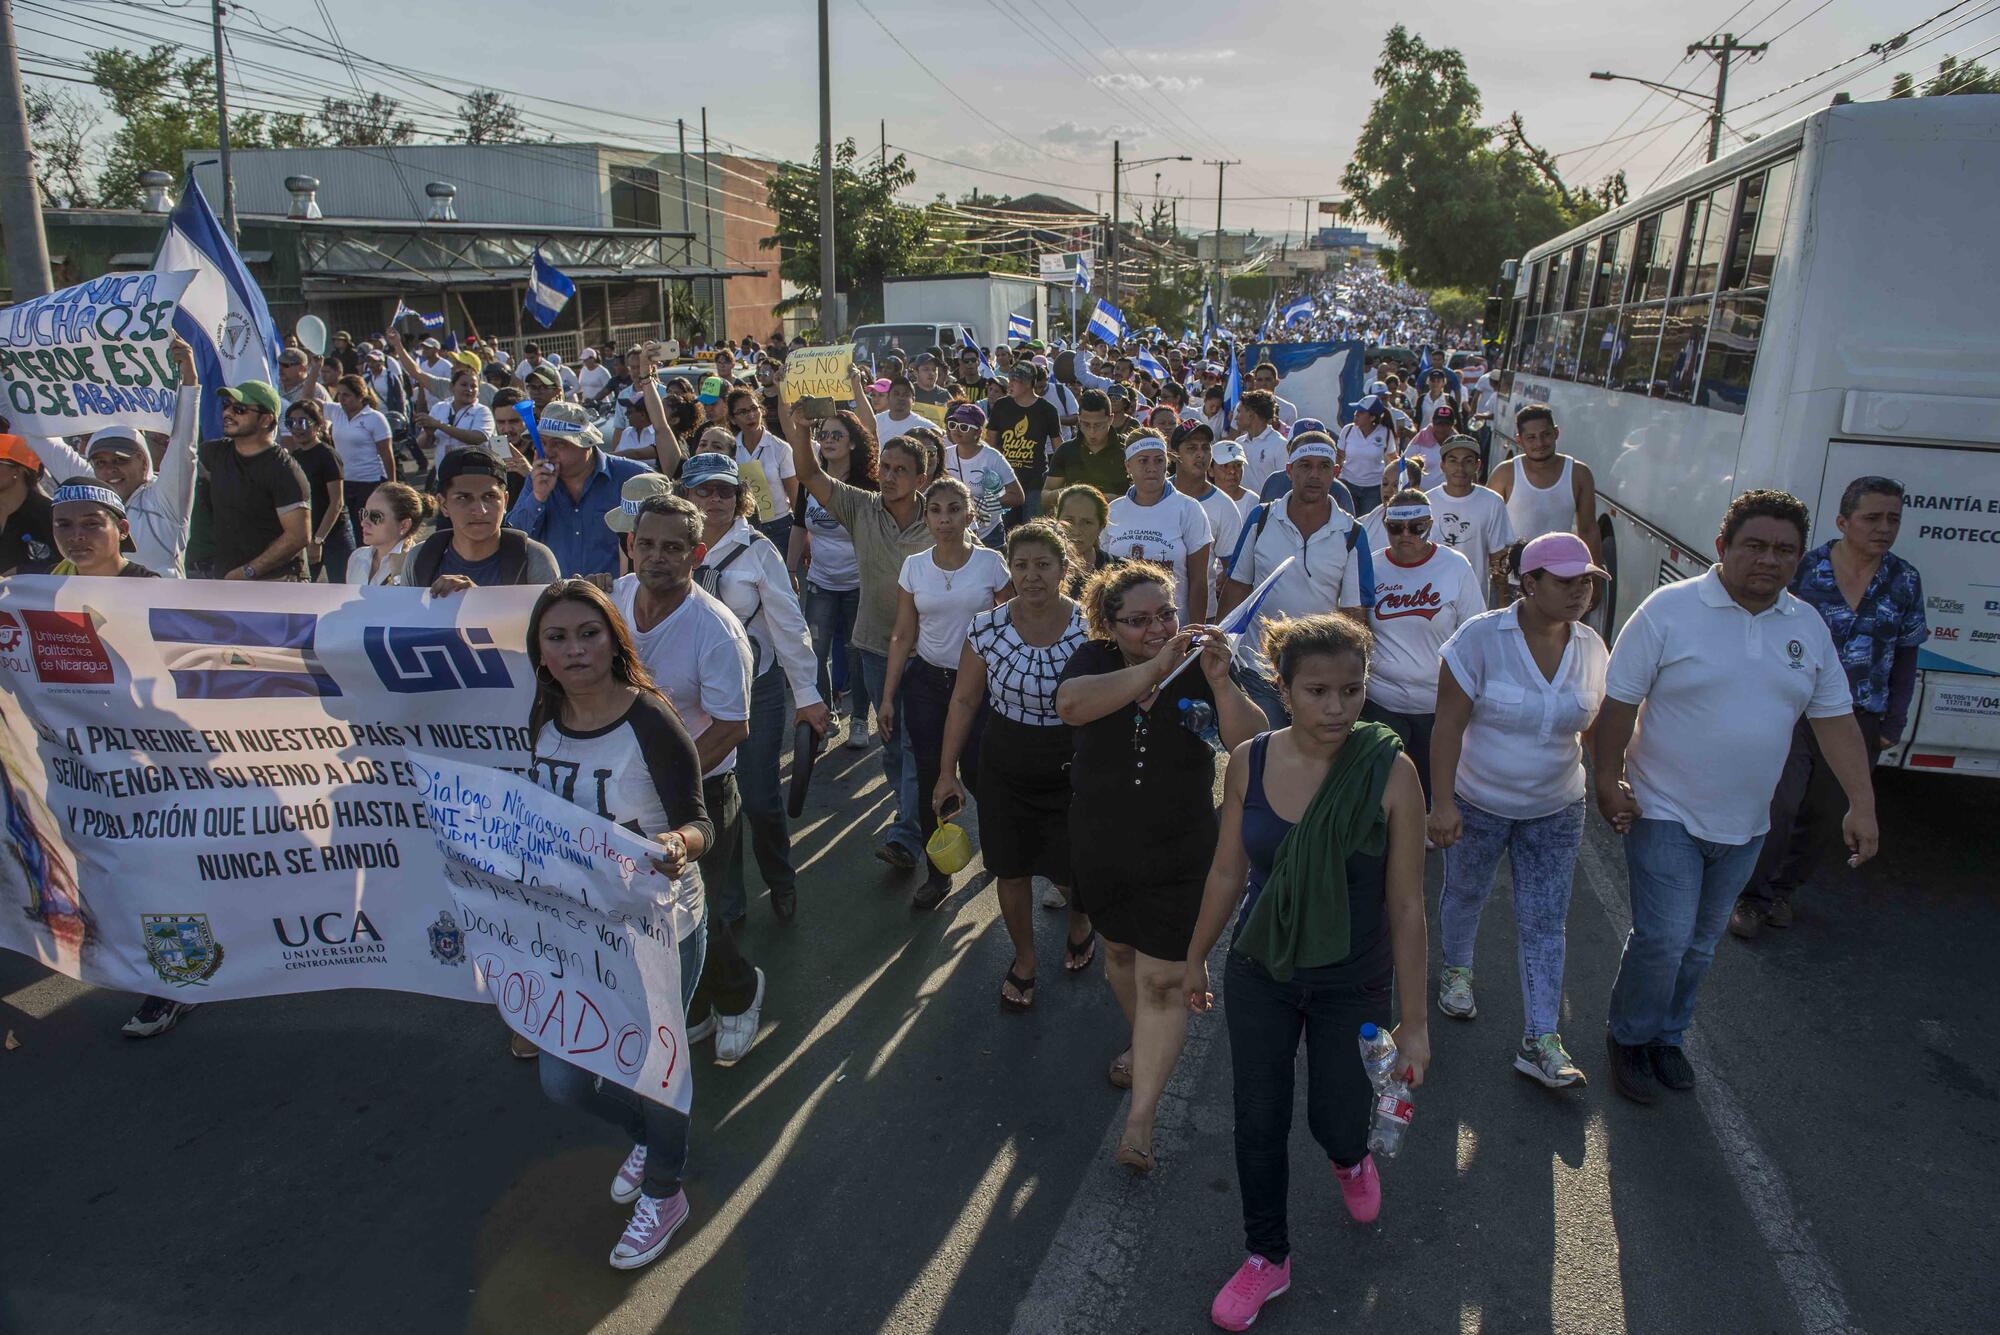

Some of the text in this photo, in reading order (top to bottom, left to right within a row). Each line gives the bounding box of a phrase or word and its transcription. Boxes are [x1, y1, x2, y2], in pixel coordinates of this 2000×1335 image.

[129, 300, 173, 341] SE
[102, 344, 152, 387] ES
[815, 357, 838, 376] NO
[786, 379, 851, 396] MATARAS
[37, 383, 78, 417] SE
[1903, 494, 1982, 512] ARANTÍA
[1375, 583, 1403, 595] Costa
[34, 631, 91, 644] Universidad
[1935, 626, 1961, 637] BAC
[38, 645, 93, 656] Politécnica
[0, 656, 30, 672] POLI
[40, 659, 108, 673] de Nicaragua
[87, 725, 136, 753] PAZ
[131, 727, 202, 753] REINE
[200, 730, 237, 753] EN
[236, 725, 347, 753] NUESTRO
[347, 721, 406, 747] PAÍS
[404, 724, 422, 747] Y
[427, 724, 533, 751] NUESTRO
[52, 756, 417, 798] SEÑOR TENGA EN SU REINO A LOS ES
[409, 760, 491, 820] Dialogo
[67, 798, 432, 839] Y POBLACIÓN QUE LUCHÓ HASTA E
[198, 838, 400, 880] NUNCA SE RINDIÓ
[518, 888, 560, 918] hora
[273, 911, 383, 947] UCA
[283, 943, 385, 960] UNIVERSIDAD
[285, 955, 388, 970] CENTROAMERICANA
[531, 922, 585, 979] dejan
